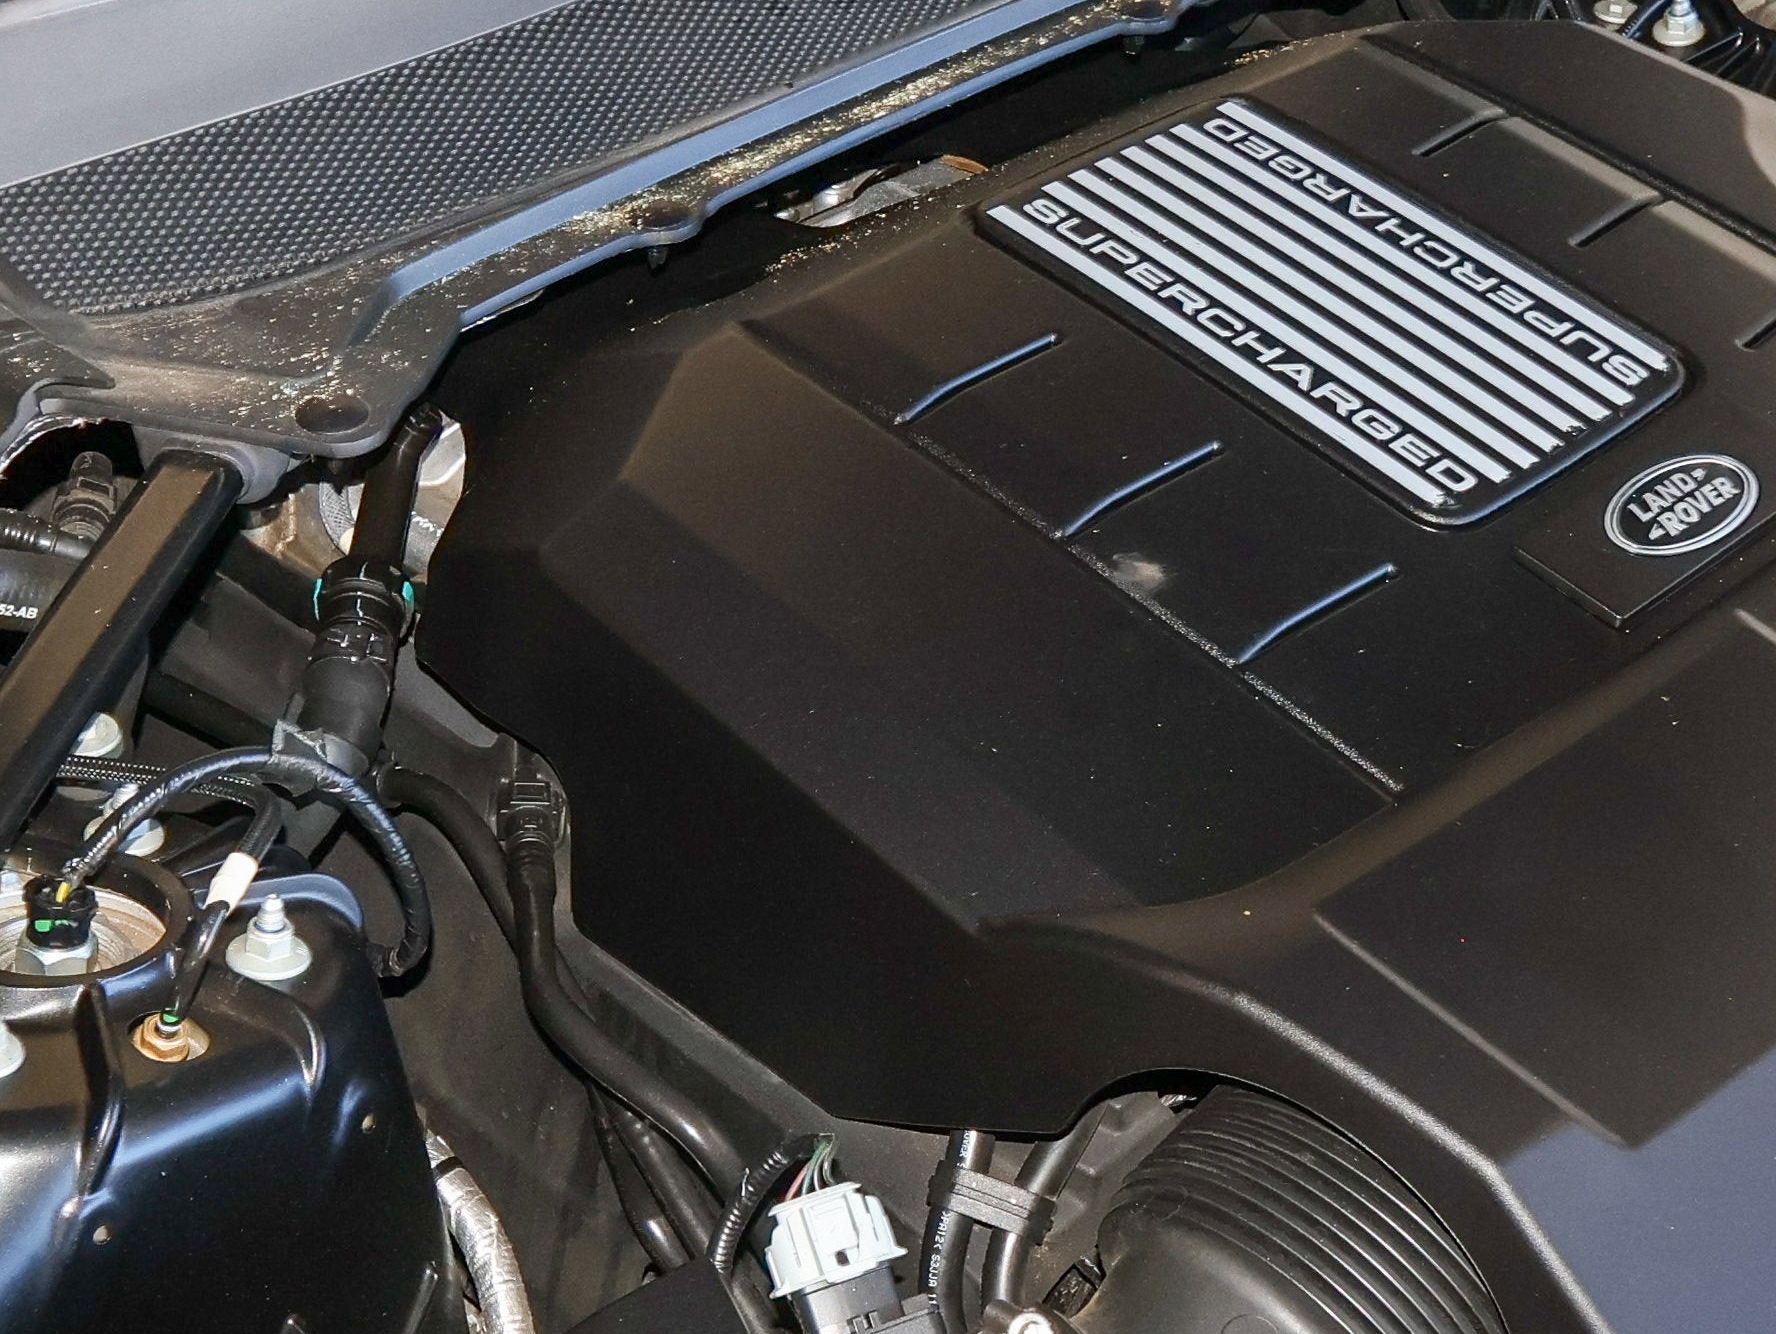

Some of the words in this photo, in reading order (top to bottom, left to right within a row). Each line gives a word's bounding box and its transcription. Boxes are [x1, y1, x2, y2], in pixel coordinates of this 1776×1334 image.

[1201, 116, 1647, 389] SUPERCHARGED
[1022, 198, 1480, 494] SUPERCHARGED
[1627, 471, 1699, 523] LAND
[1656, 476, 1742, 537] ROVER
